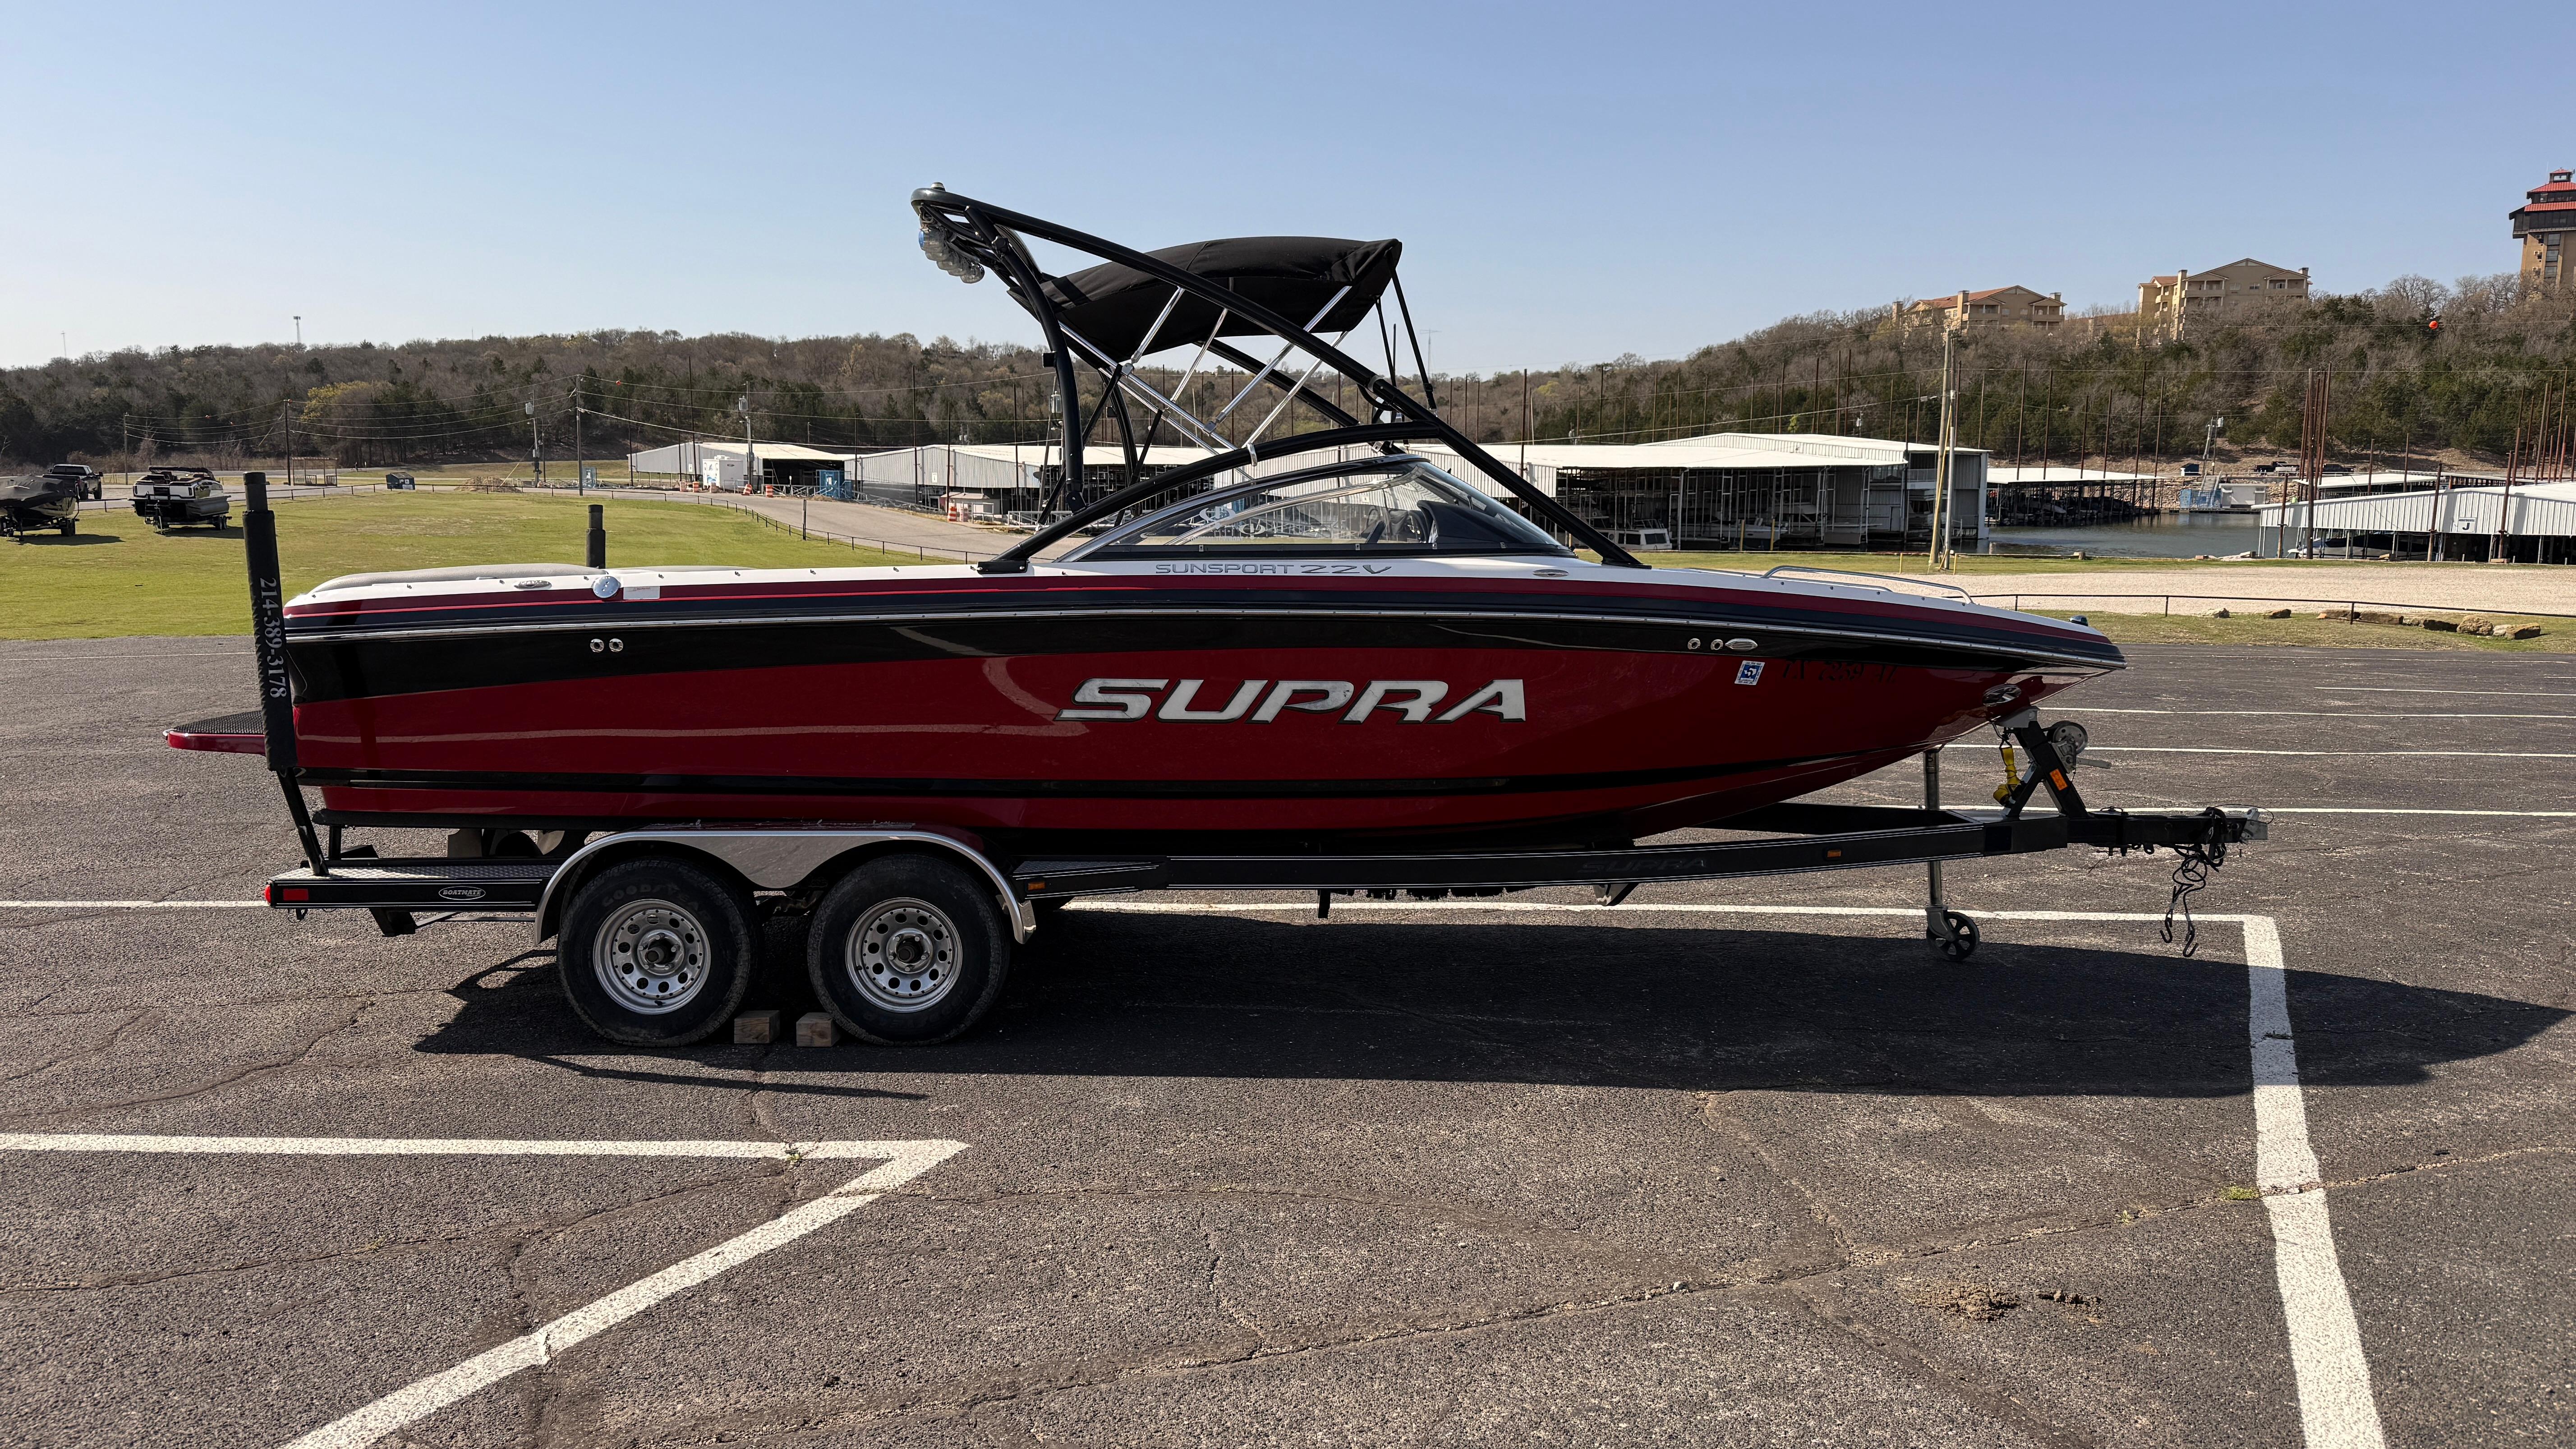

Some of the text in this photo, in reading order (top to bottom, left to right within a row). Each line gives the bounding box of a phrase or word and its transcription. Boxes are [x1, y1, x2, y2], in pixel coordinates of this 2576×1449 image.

[2462, 522, 2470, 530] J
[1156, 563, 1392, 574] SUNSPORT 22V
[260, 577, 287, 698] 214-389-3178
[1053, 677, 1526, 724] SUPRA
[1576, 857, 1707, 873] SUPRA
